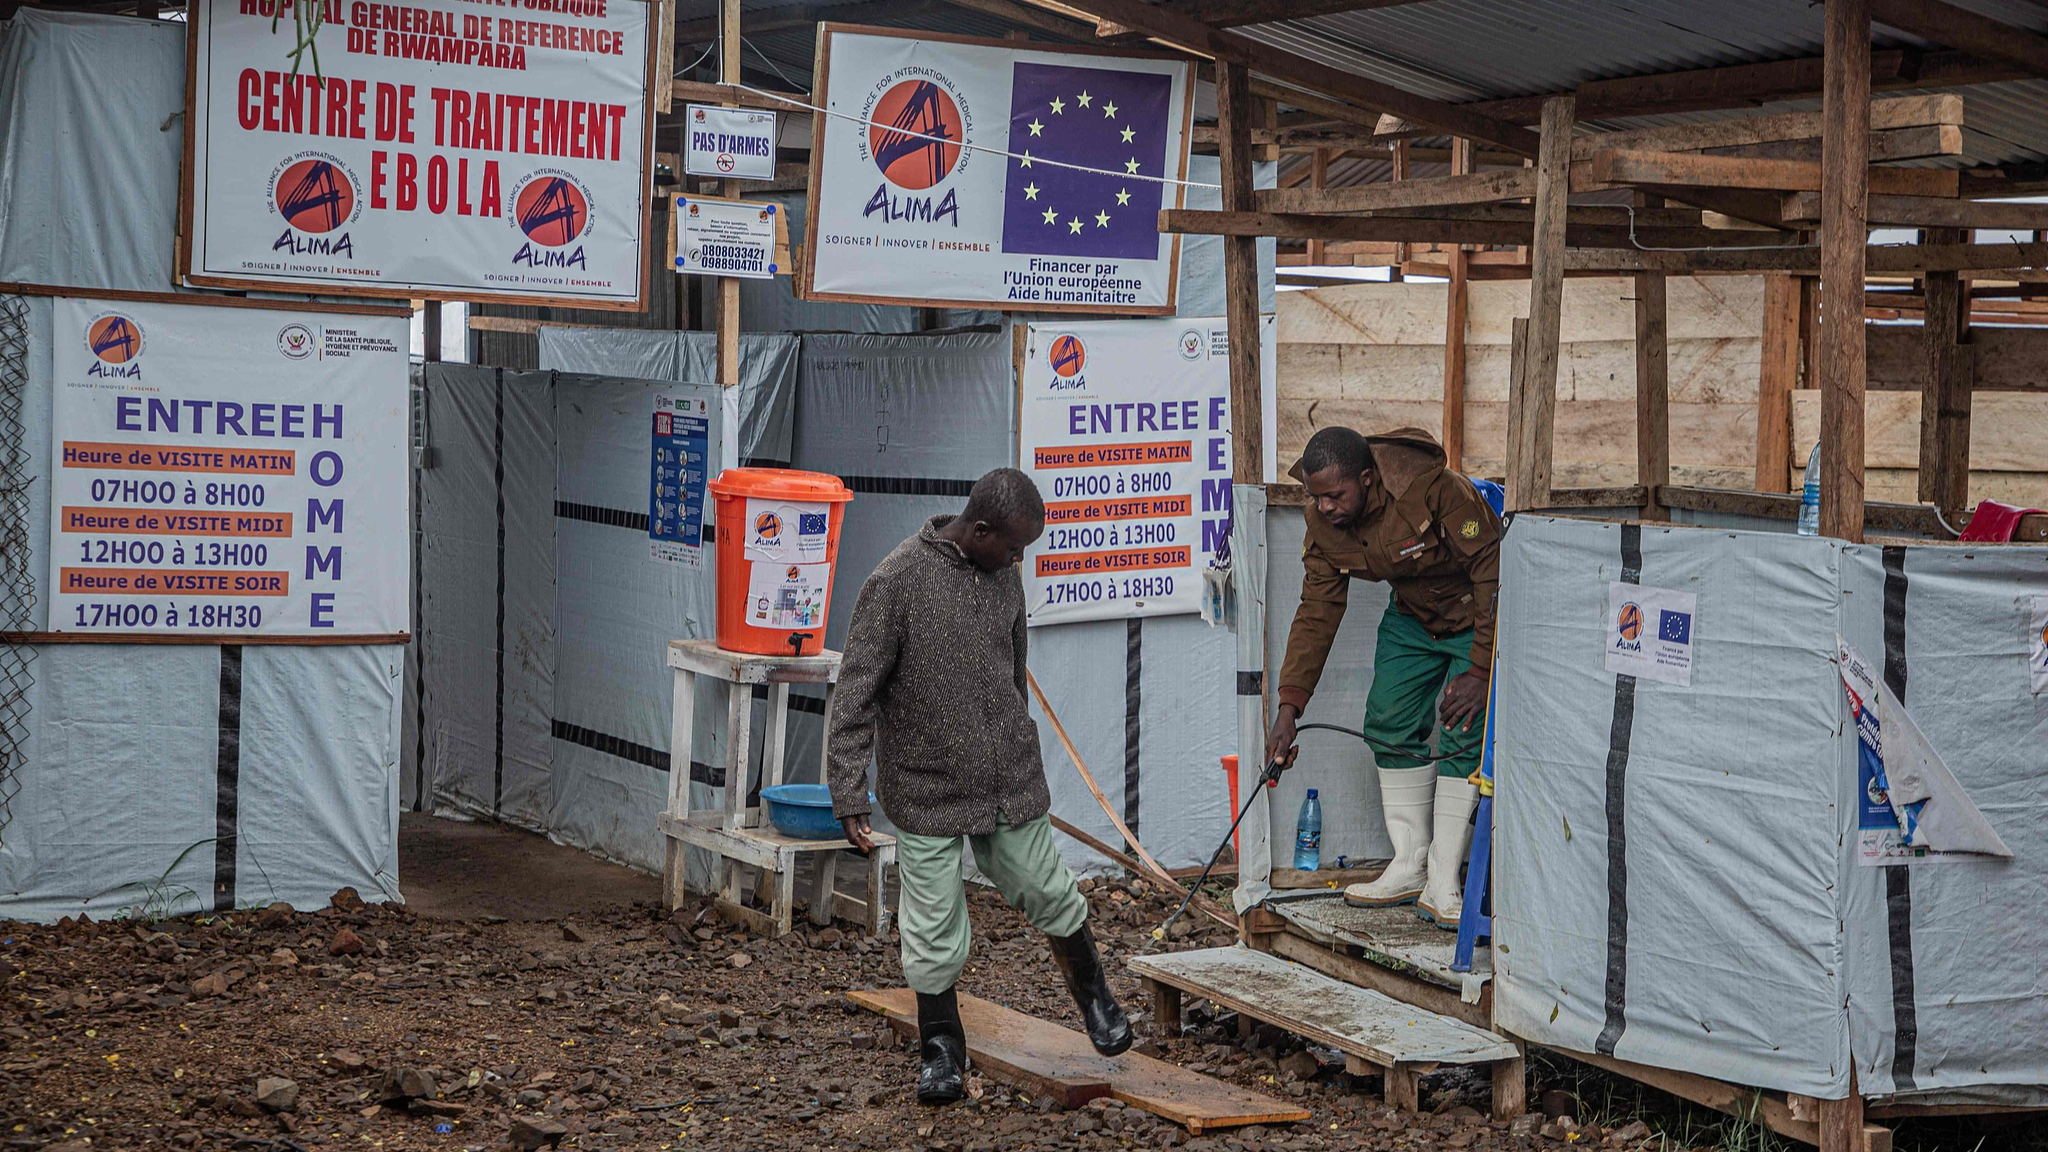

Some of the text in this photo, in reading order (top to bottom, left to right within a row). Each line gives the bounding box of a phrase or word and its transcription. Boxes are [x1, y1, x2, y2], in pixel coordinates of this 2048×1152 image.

[351, 1, 457, 37] GENERAL
[463, 14, 492, 41] DE
[499, 18, 624, 56] REFERENCE
[347, 27, 526, 71] DE RWAMPARA
[237, 68, 627, 161] CENTRE DE TRAITEMENT
[858, 142, 869, 162] THE
[876, 75, 893, 92] FOR
[894, 66, 956, 93] INTERNATIONAL
[955, 92, 973, 134] MEDICAL
[692, 131, 769, 157] PAS D'ARMES
[266, 150, 363, 224] THE ALLIANCE FOR INTERNATIONAL MEDICAL ACTION
[371, 150, 502, 218] EBOLA
[507, 168, 596, 237] THE ALLIANCE FOR INTERNATIONAL MEDICAL ACTION
[862, 182, 960, 228] ALIMA
[272, 228, 354, 259] ALIMA
[702, 244, 765, 260] 0808033421
[825, 235, 990, 252] SOIGNER INNOVER ENSEMBLE
[512, 241, 587, 271] ALIMA
[701, 256, 762, 272] 0988904701
[1029, 258, 1119, 275] Financer par
[242, 261, 381, 276] SOIGNER INNOVER ENSEMBLE
[484, 274, 612, 288] SOIGNER INNOVER ENSEMBLE
[1003, 271, 1142, 291] l'Union européenne
[1008, 286, 1040, 301] Aide
[342, 336, 362, 344] SANTÉ
[87, 360, 141, 381] ALIMA
[1049, 374, 1086, 391] ALIMA
[116, 396, 305, 438] ENTREE
[1069, 401, 1199, 435] ENTREE
[63, 448, 293, 470] Heure de VISITE MATIN
[1035, 446, 1190, 466] Heure de VISITE MATIN
[184, 479, 197, 505] à
[205, 482, 265, 507] 8H00
[1116, 472, 1125, 494] à
[1131, 471, 1172, 493] 8H00
[1201, 397, 1233, 567] FEMM
[1084, 505, 1100, 518] de
[1104, 502, 1149, 517] VISITE
[1153, 500, 1185, 514] MIDI
[70, 513, 284, 532] Heure de VISITE MIDI
[755, 536, 781, 547] ALIMA
[1109, 525, 1118, 546] à
[1124, 523, 1175, 545] 13H00
[172, 540, 186, 566] à
[195, 543, 268, 567] 13H00
[1041, 551, 1186, 572] Heure de VISITE SOIR
[68, 573, 282, 592] Heure de VISITE SOIR
[1108, 578, 1117, 600] à
[1123, 576, 1173, 599] 18H30
[166, 602, 179, 628] à
[187, 604, 262, 628] 18H30
[1616, 637, 1641, 653] ALIMA
